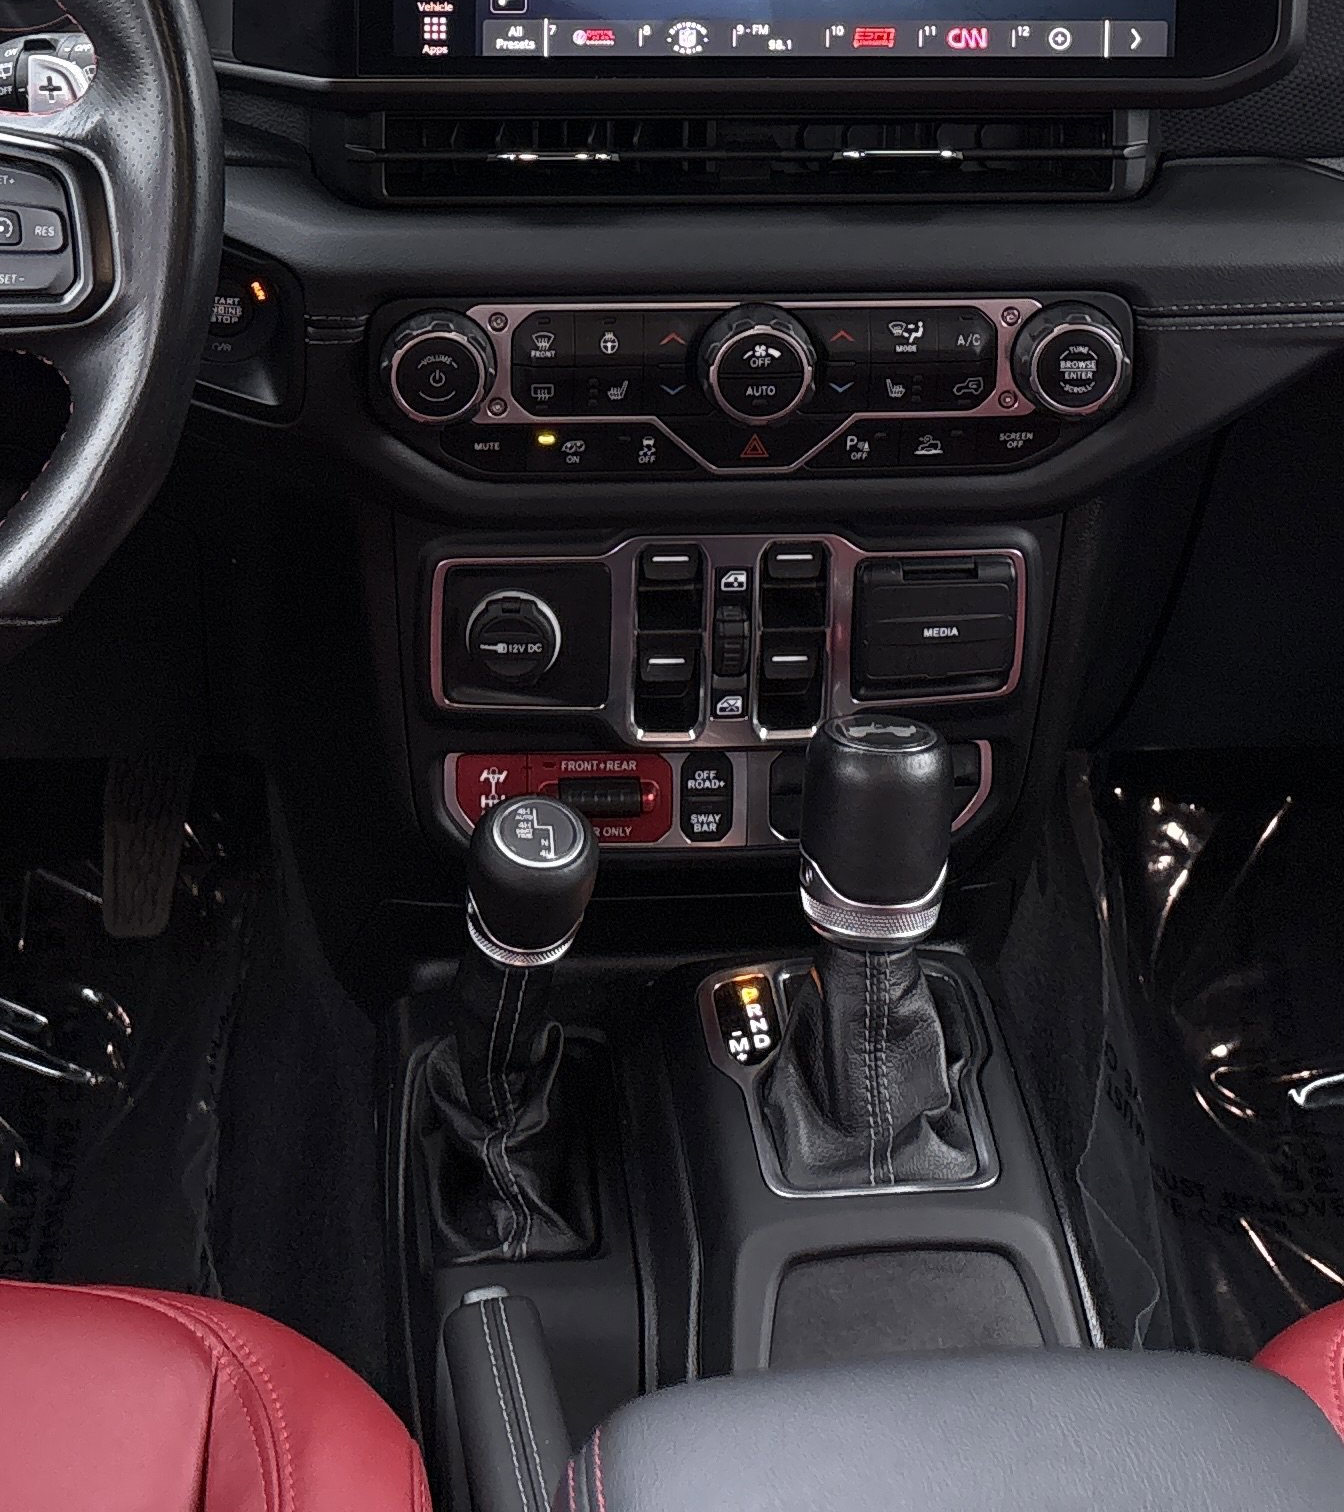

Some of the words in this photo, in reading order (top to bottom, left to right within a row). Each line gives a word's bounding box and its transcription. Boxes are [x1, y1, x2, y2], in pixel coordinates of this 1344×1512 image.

[416, 0, 454, 13] Vehicle
[507, 25, 523, 38] All
[751, 24, 770, 36] FM
[830, 24, 845, 37] 10
[924, 24, 937, 37] 11
[1017, 24, 1031, 37] 12
[946, 26, 989, 49] CNN
[421, 43, 449, 57] Apps
[495, 38, 536, 51] Presets
[4, 47, 19, 58] ON
[34, 225, 55, 237] RES
[957, 333, 981, 347] A/C
[530, 349, 556, 359] FRONT
[895, 344, 918, 354] MODE
[1068, 345, 1090, 355] TUNE
[420, 353, 454, 367] VOLUME
[749, 356, 772, 369] OFF
[1059, 359, 1097, 370] BROWSE
[1063, 370, 1094, 381] ENTER
[745, 385, 777, 397] AUTO
[1063, 383, 1093, 394] SCROLL
[999, 431, 1034, 441] SCREEN
[473, 441, 501, 452] MUTE
[1006, 440, 1025, 449] OFF
[565, 455, 581, 465] ON
[637, 455, 656, 465] OFF
[850, 451, 869, 461] OFF
[923, 626, 959, 638] MEDIA
[507, 643, 526, 654] 12V
[527, 643, 544, 653] DC
[694, 770, 717, 781] OFF
[687, 779, 726, 790] ROAD+
[690, 813, 722, 825] SWAY
[602, 825, 634, 837] ONLY
[693, 823, 718, 833] BAR
[745, 1003, 764, 1018] R
[749, 1017, 769, 1033] N
[753, 1033, 772, 1050] D
